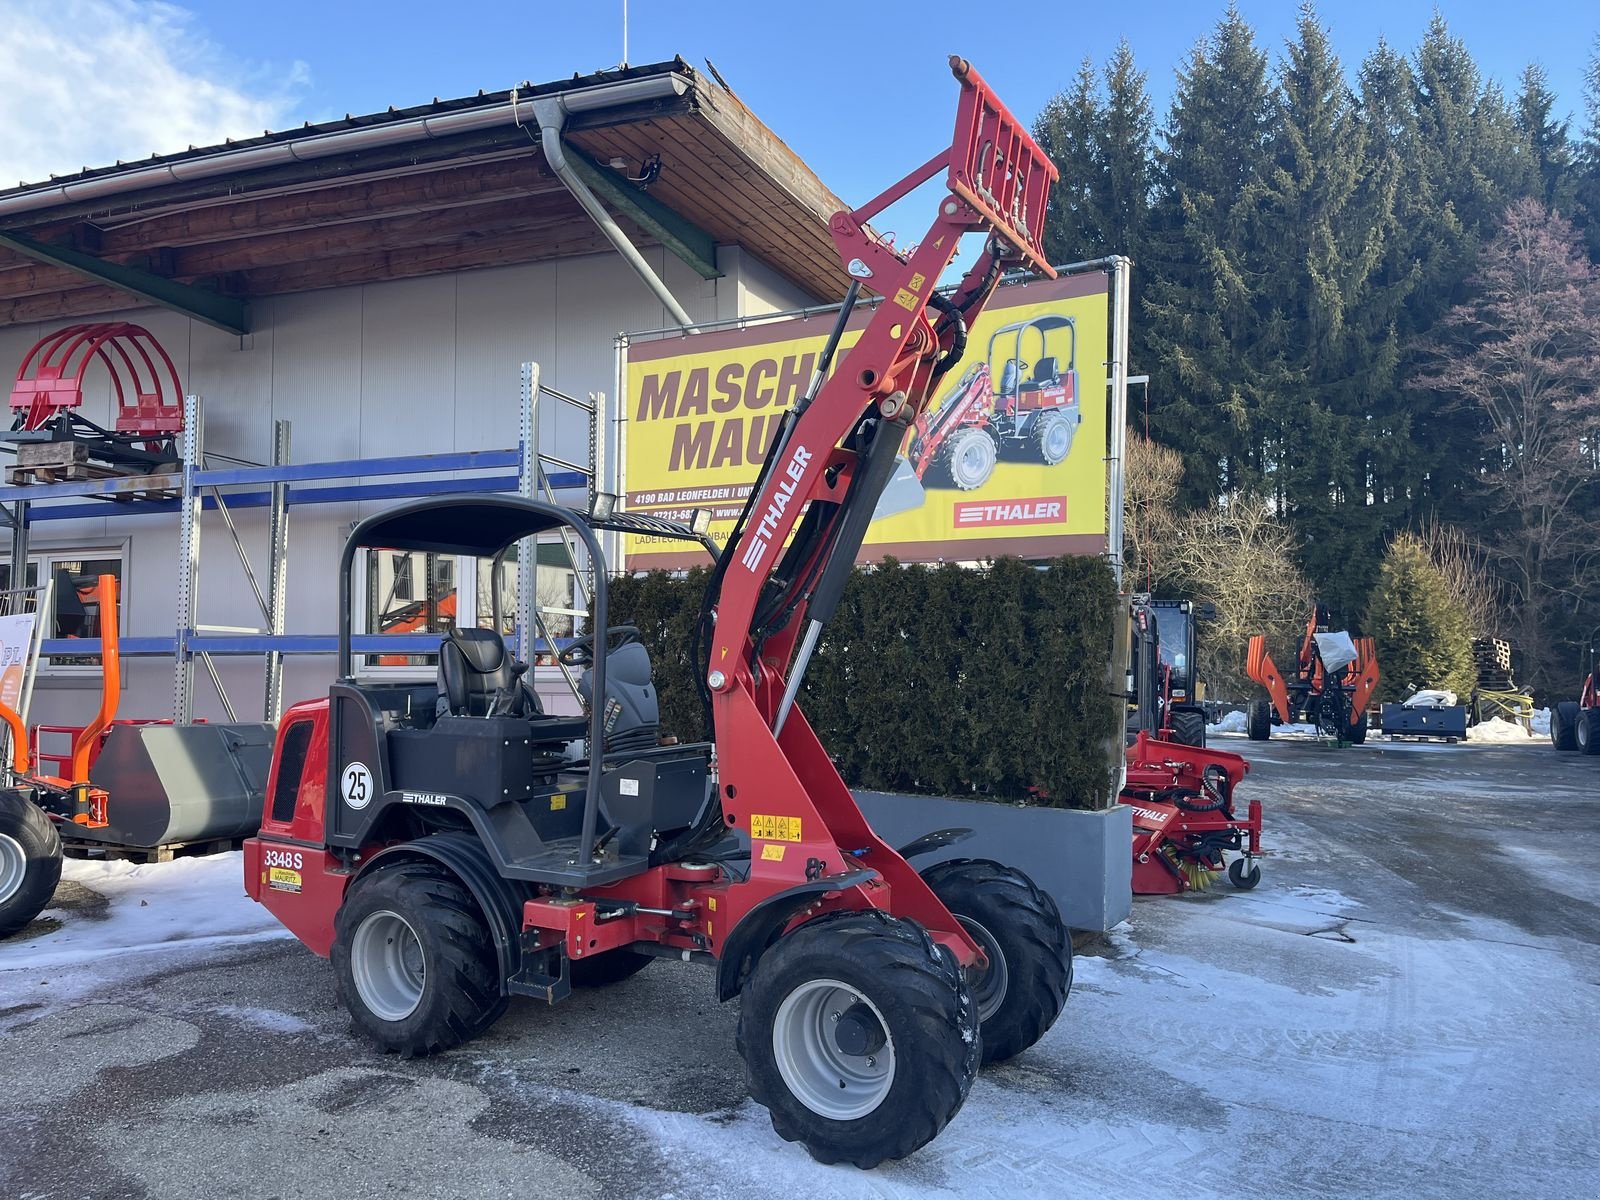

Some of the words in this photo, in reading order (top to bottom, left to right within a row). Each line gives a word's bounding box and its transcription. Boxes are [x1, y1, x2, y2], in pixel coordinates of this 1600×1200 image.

[635, 493, 656, 504] 4190
[657, 492, 675, 502] BAD
[676, 487, 729, 501] LEONFELDEN
[348, 770, 367, 801] 25
[264, 850, 293, 868] 3348
[293, 852, 303, 870] S
